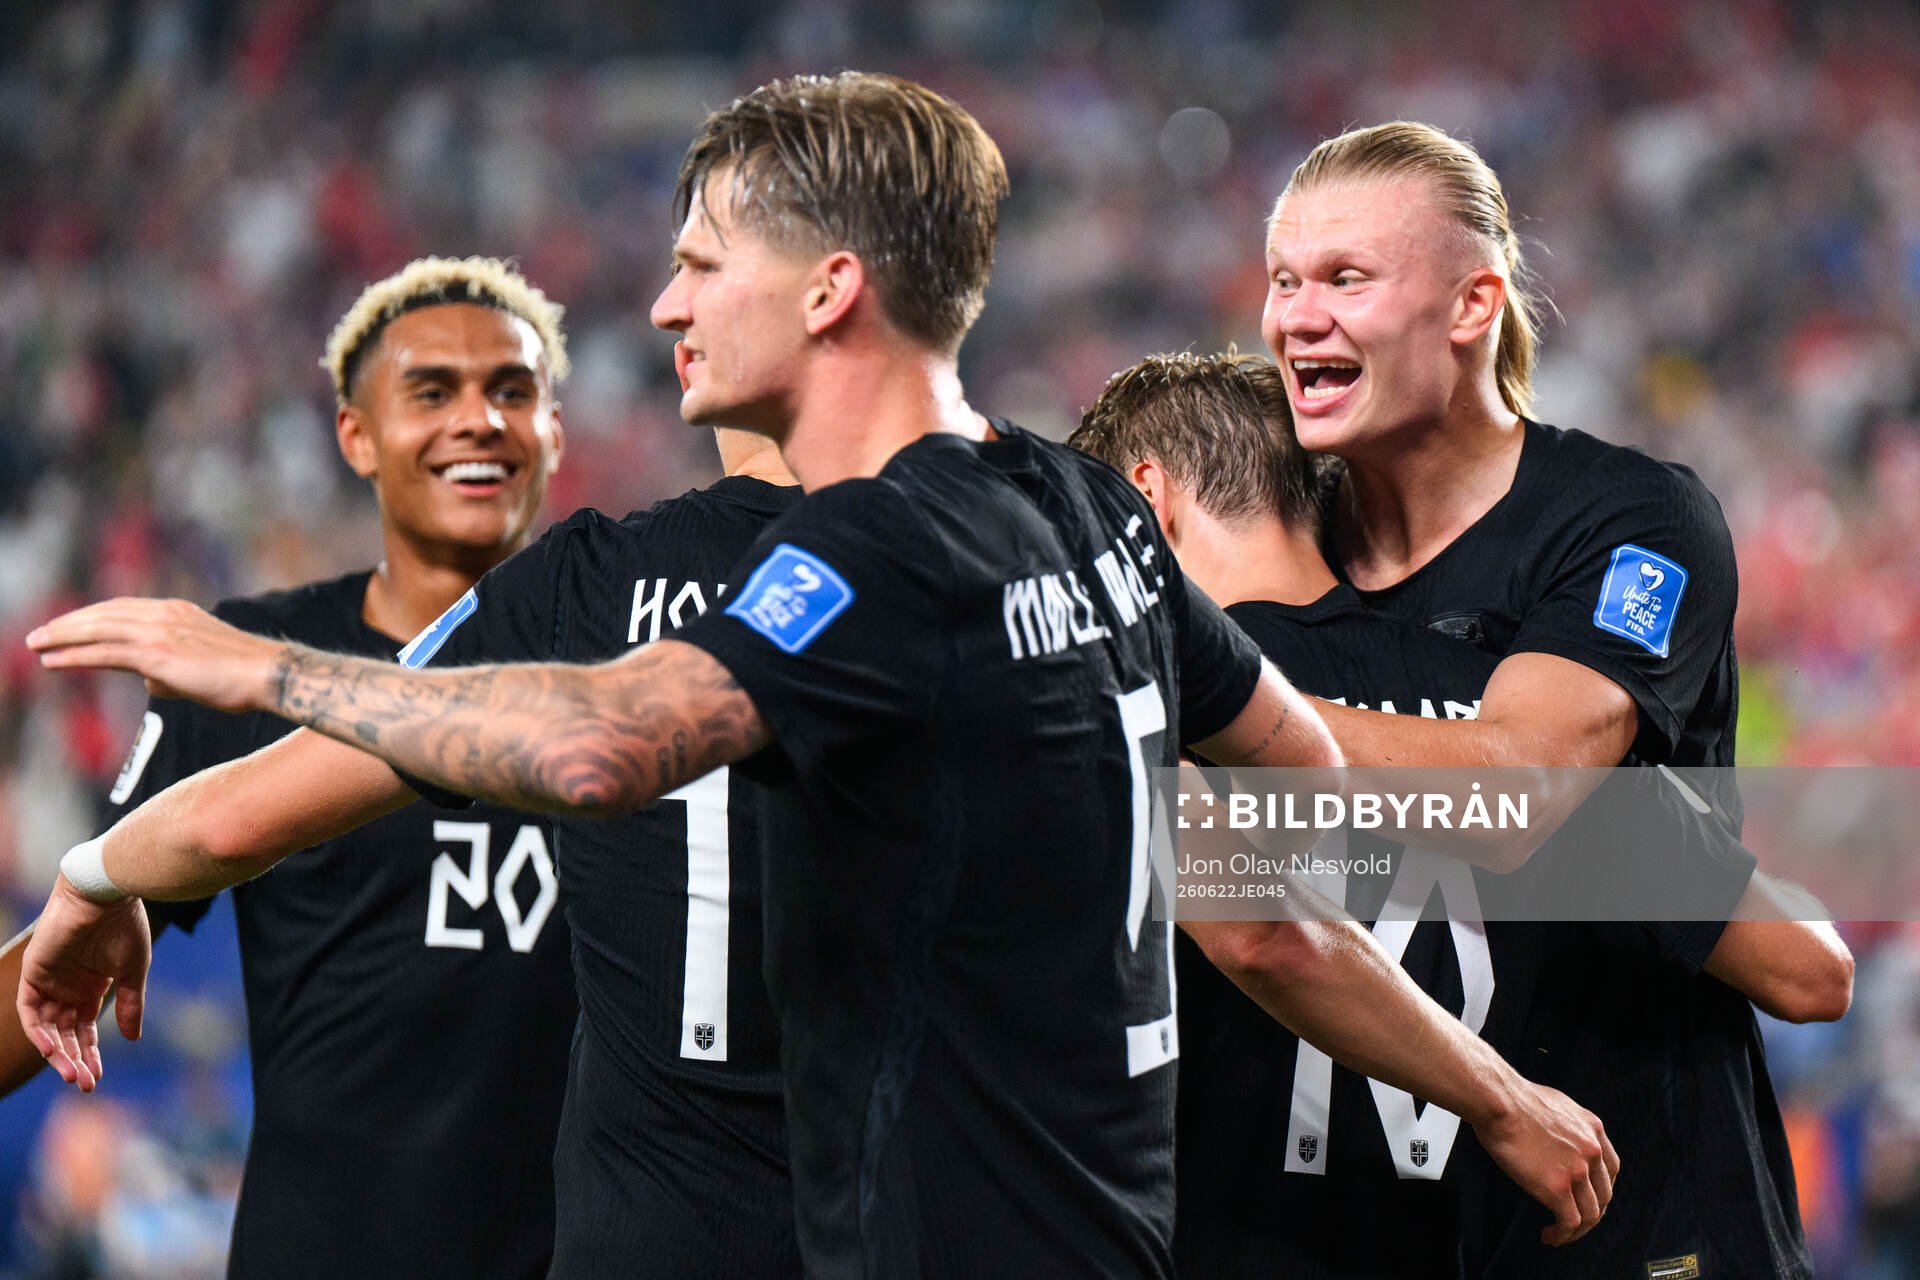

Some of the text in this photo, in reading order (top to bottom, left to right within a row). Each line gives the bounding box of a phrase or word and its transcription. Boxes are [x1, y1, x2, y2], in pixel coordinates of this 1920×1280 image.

[627, 578, 728, 644] HO
[1622, 585, 1662, 612] Unite For
[1622, 601, 1656, 630] PEACE
[1625, 619, 1645, 635] FIFA
[424, 819, 559, 954] 20
[1115, 680, 1179, 1078] 5
[1284, 832, 1496, 1181] 10
